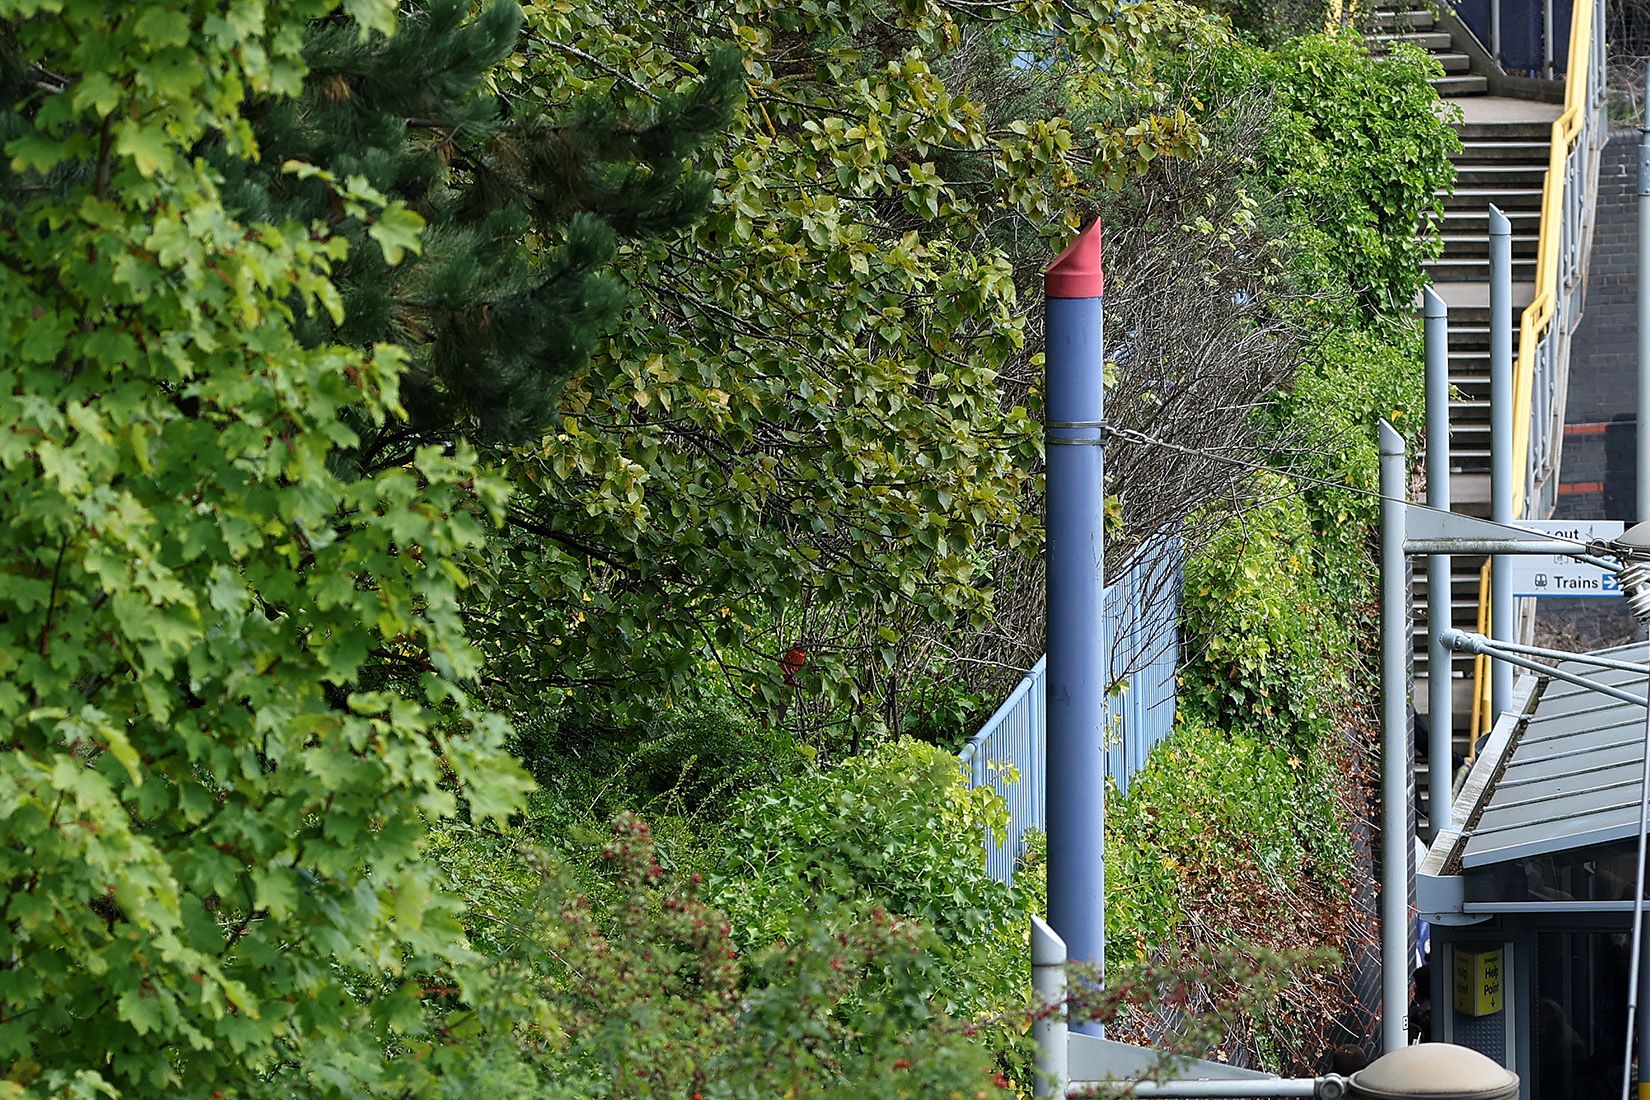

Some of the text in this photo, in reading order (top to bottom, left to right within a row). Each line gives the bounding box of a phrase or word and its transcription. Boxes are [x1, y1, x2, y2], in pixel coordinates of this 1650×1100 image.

[1553, 575, 1599, 589] Trains
[1485, 965, 1499, 979] Help
[1484, 983, 1499, 996] Point
